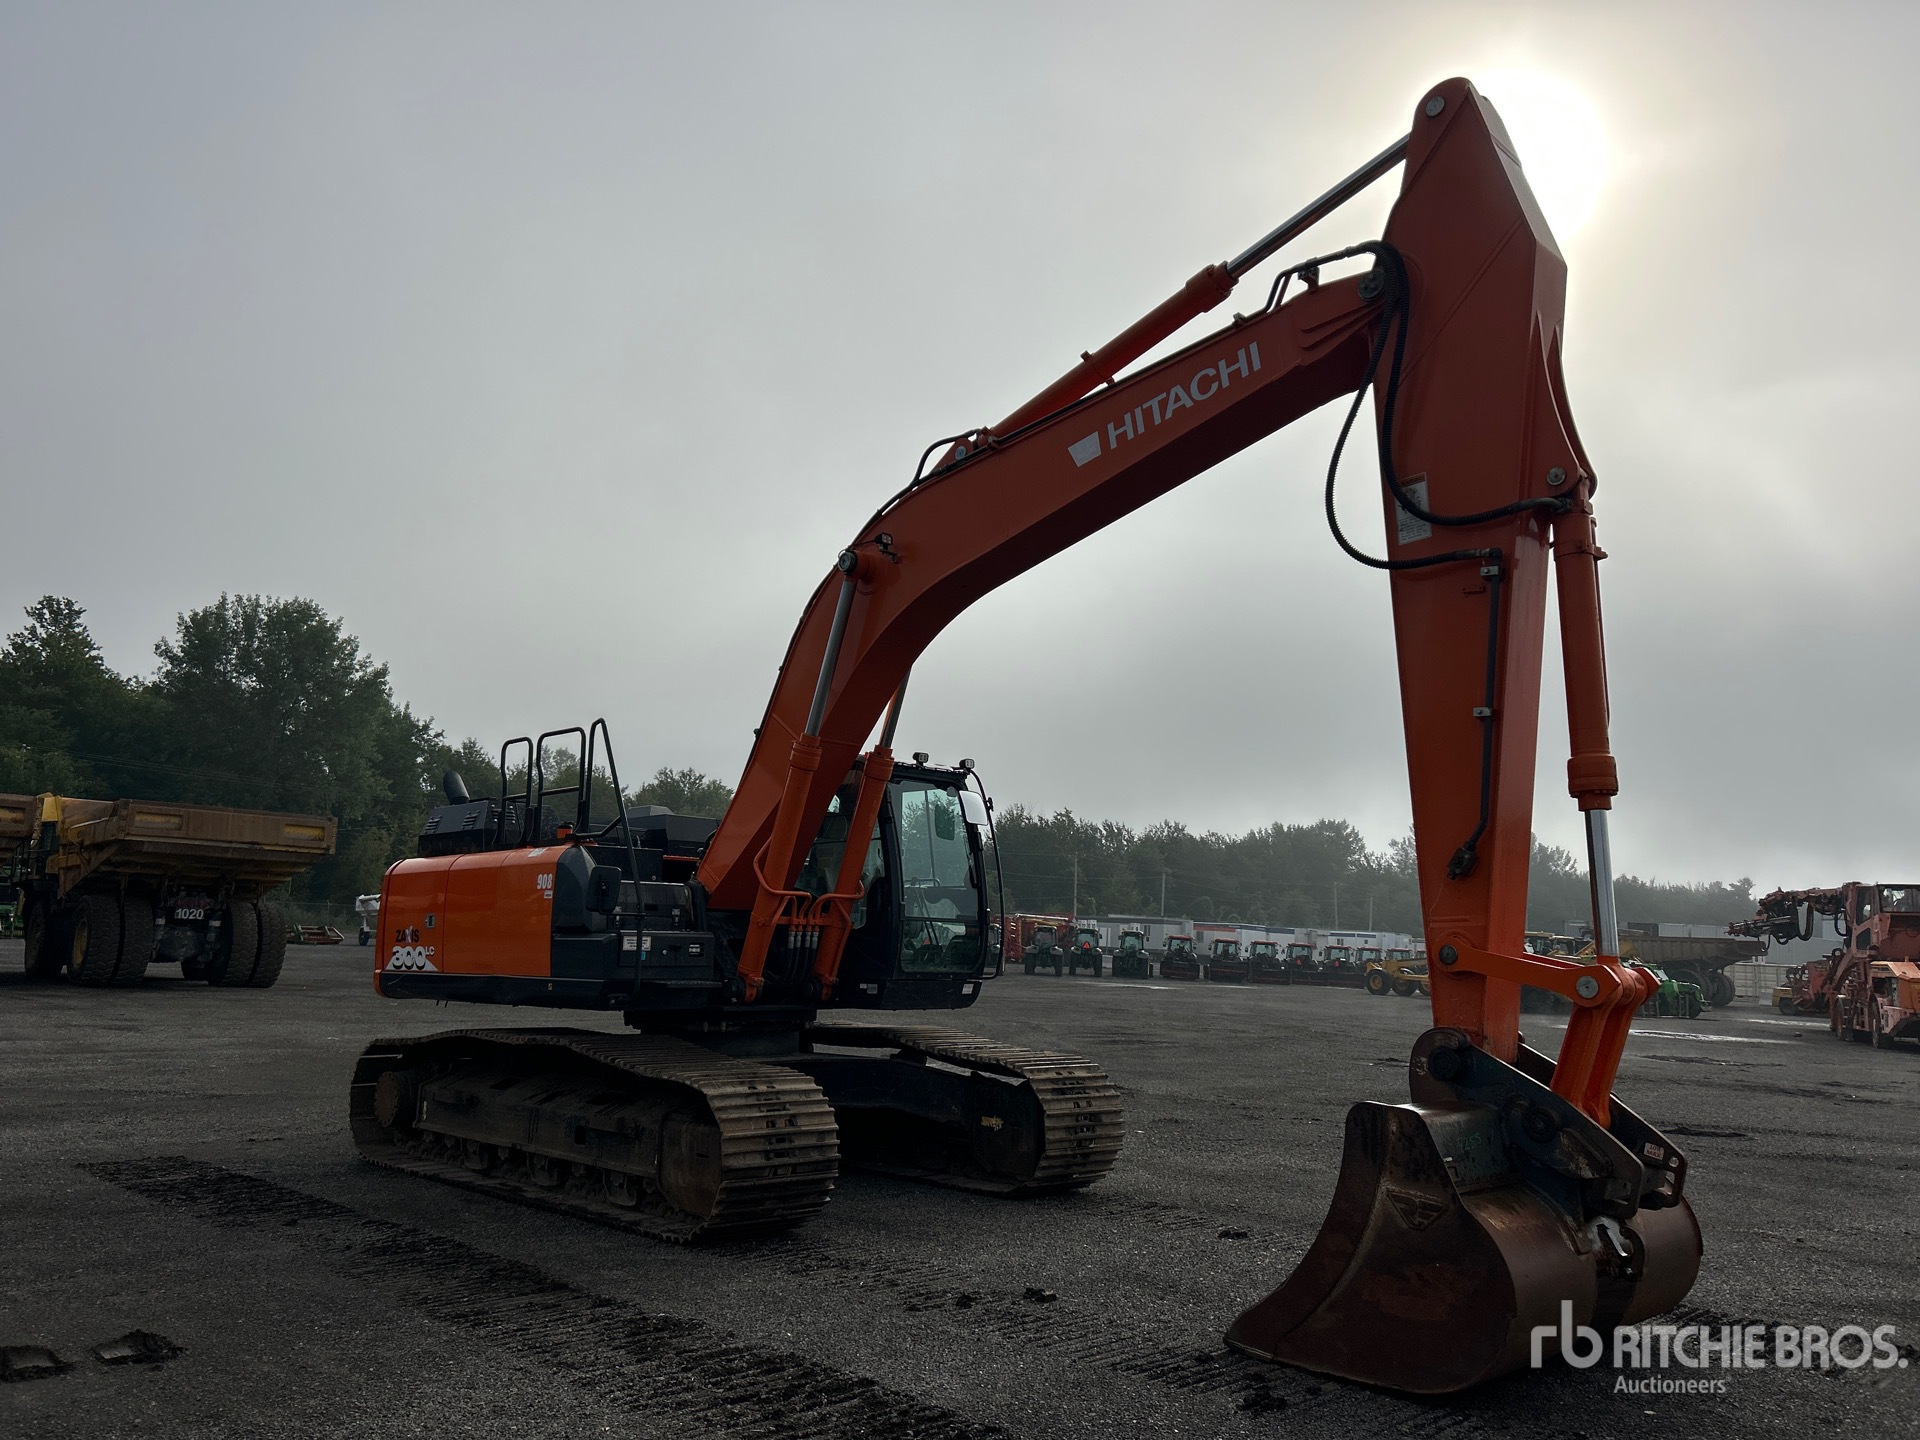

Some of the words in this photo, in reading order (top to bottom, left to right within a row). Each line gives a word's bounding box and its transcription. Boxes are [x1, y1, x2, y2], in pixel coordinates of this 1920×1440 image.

[1107, 341, 1261, 450] HITACHI
[537, 873, 553, 890] 908
[175, 908, 205, 920] 1020
